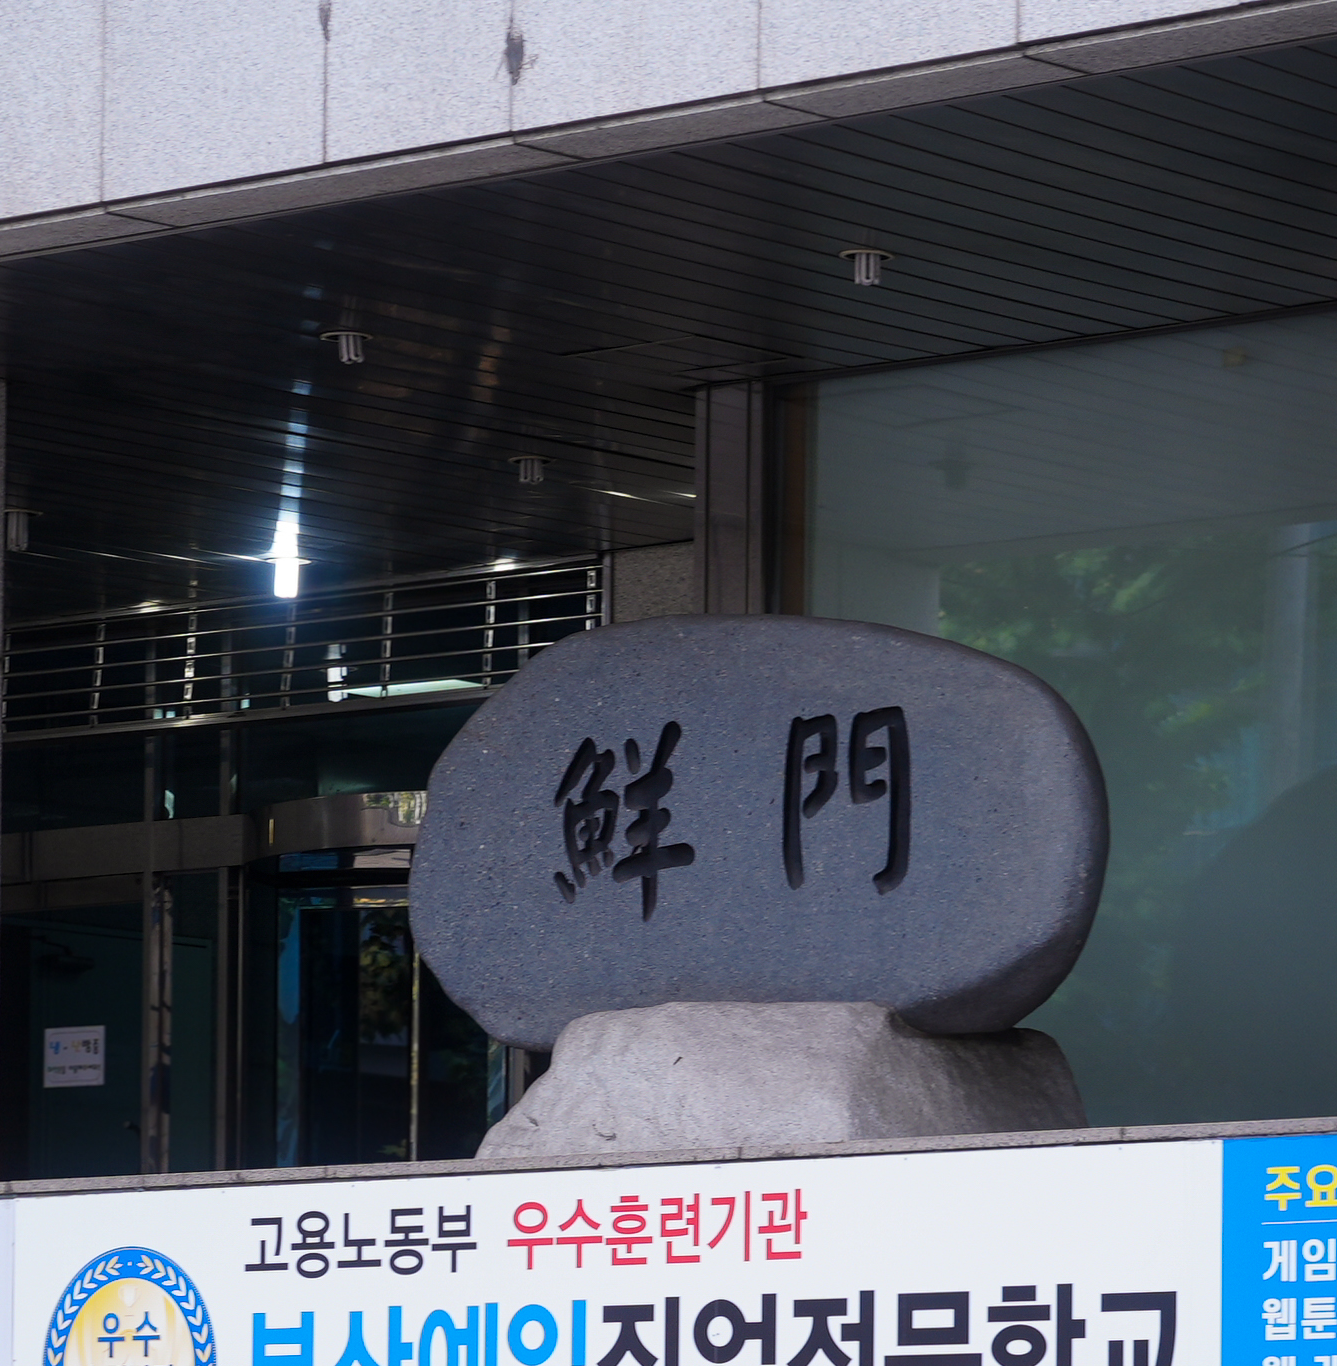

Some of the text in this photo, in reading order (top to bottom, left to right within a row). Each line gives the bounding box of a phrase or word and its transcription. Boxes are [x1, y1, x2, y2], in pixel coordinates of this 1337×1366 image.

[553, 706, 912, 922] 鮮門
[245, 1188, 808, 1279] 고용노동부 우수훈련기관
